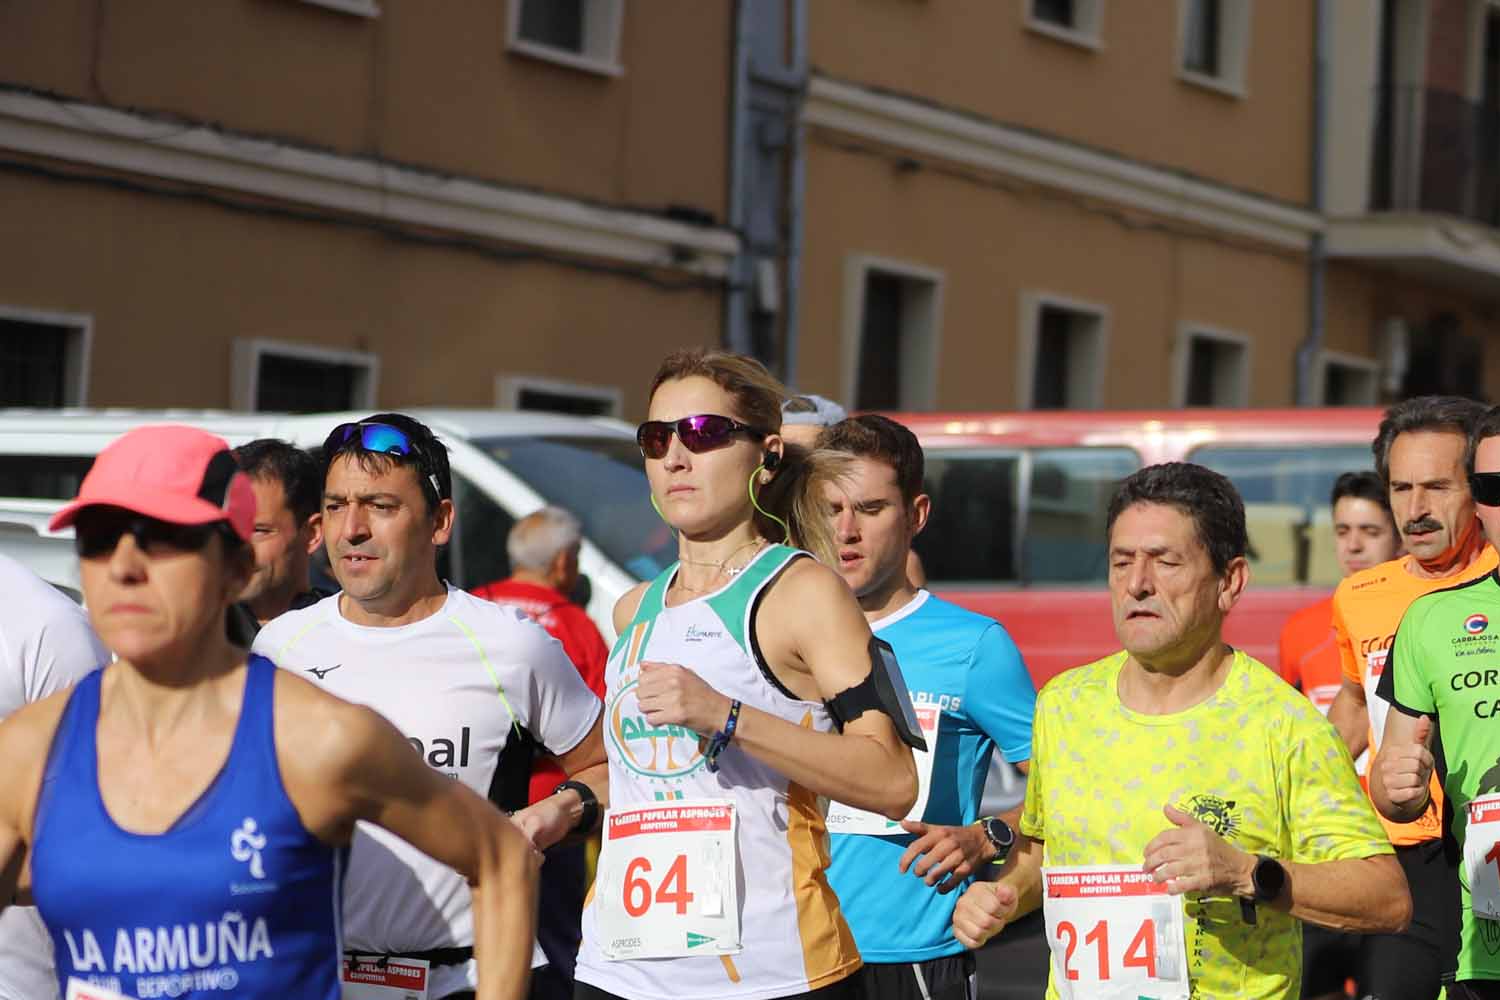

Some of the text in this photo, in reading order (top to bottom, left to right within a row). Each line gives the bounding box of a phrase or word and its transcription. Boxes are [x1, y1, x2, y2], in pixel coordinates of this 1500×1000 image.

[1451, 634, 1500, 645] CARBAJOSA
[643, 809, 678, 821] POPULAR
[623, 854, 694, 917] 64
[1081, 874, 1121, 885] POPULAR
[63, 911, 274, 973] LA ARMUÑA
[1056, 918, 1157, 981] 214
